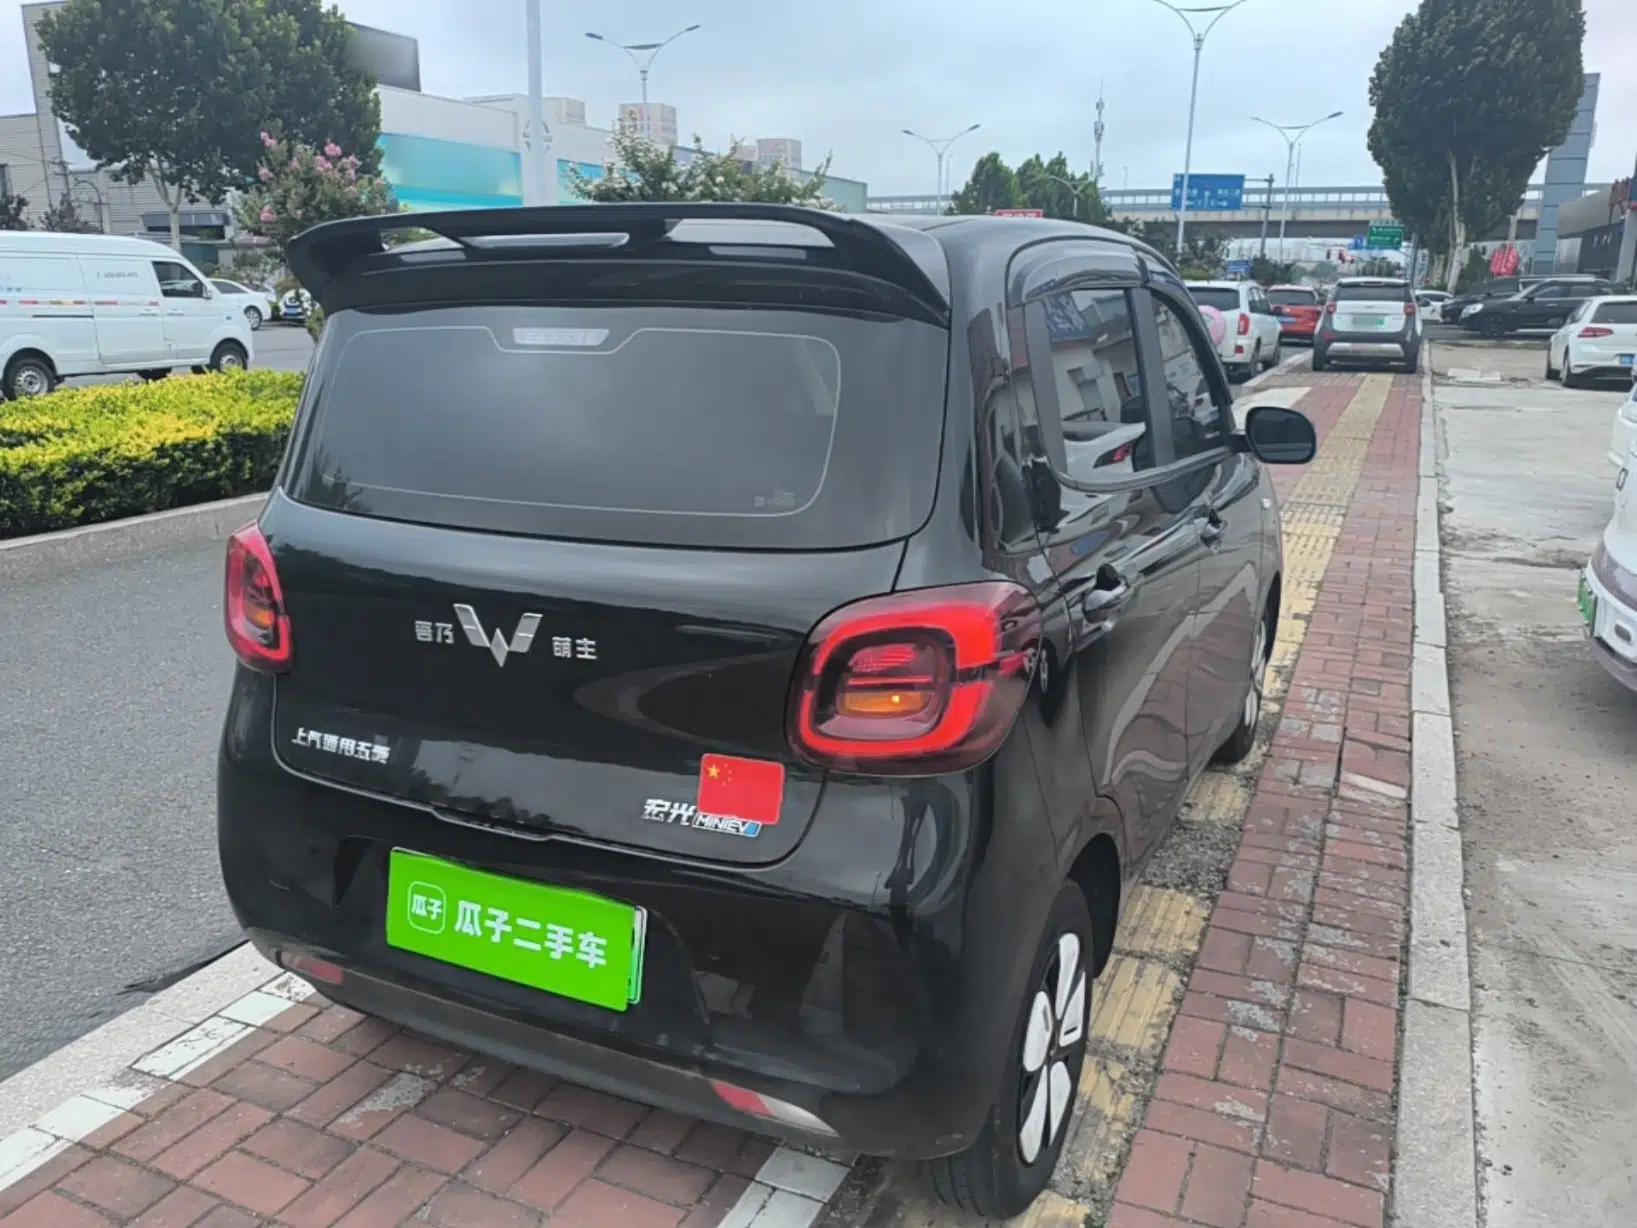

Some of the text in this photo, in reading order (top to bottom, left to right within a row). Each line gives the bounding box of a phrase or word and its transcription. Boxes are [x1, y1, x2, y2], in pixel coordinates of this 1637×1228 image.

[552, 636, 598, 660] 萌主
[291, 727, 391, 764] 上汽通用五菱
[641, 799, 751, 833] 宏光 MINIEV
[411, 894, 443, 920] 瓜子
[454, 900, 607, 968] 瓜子二手车
